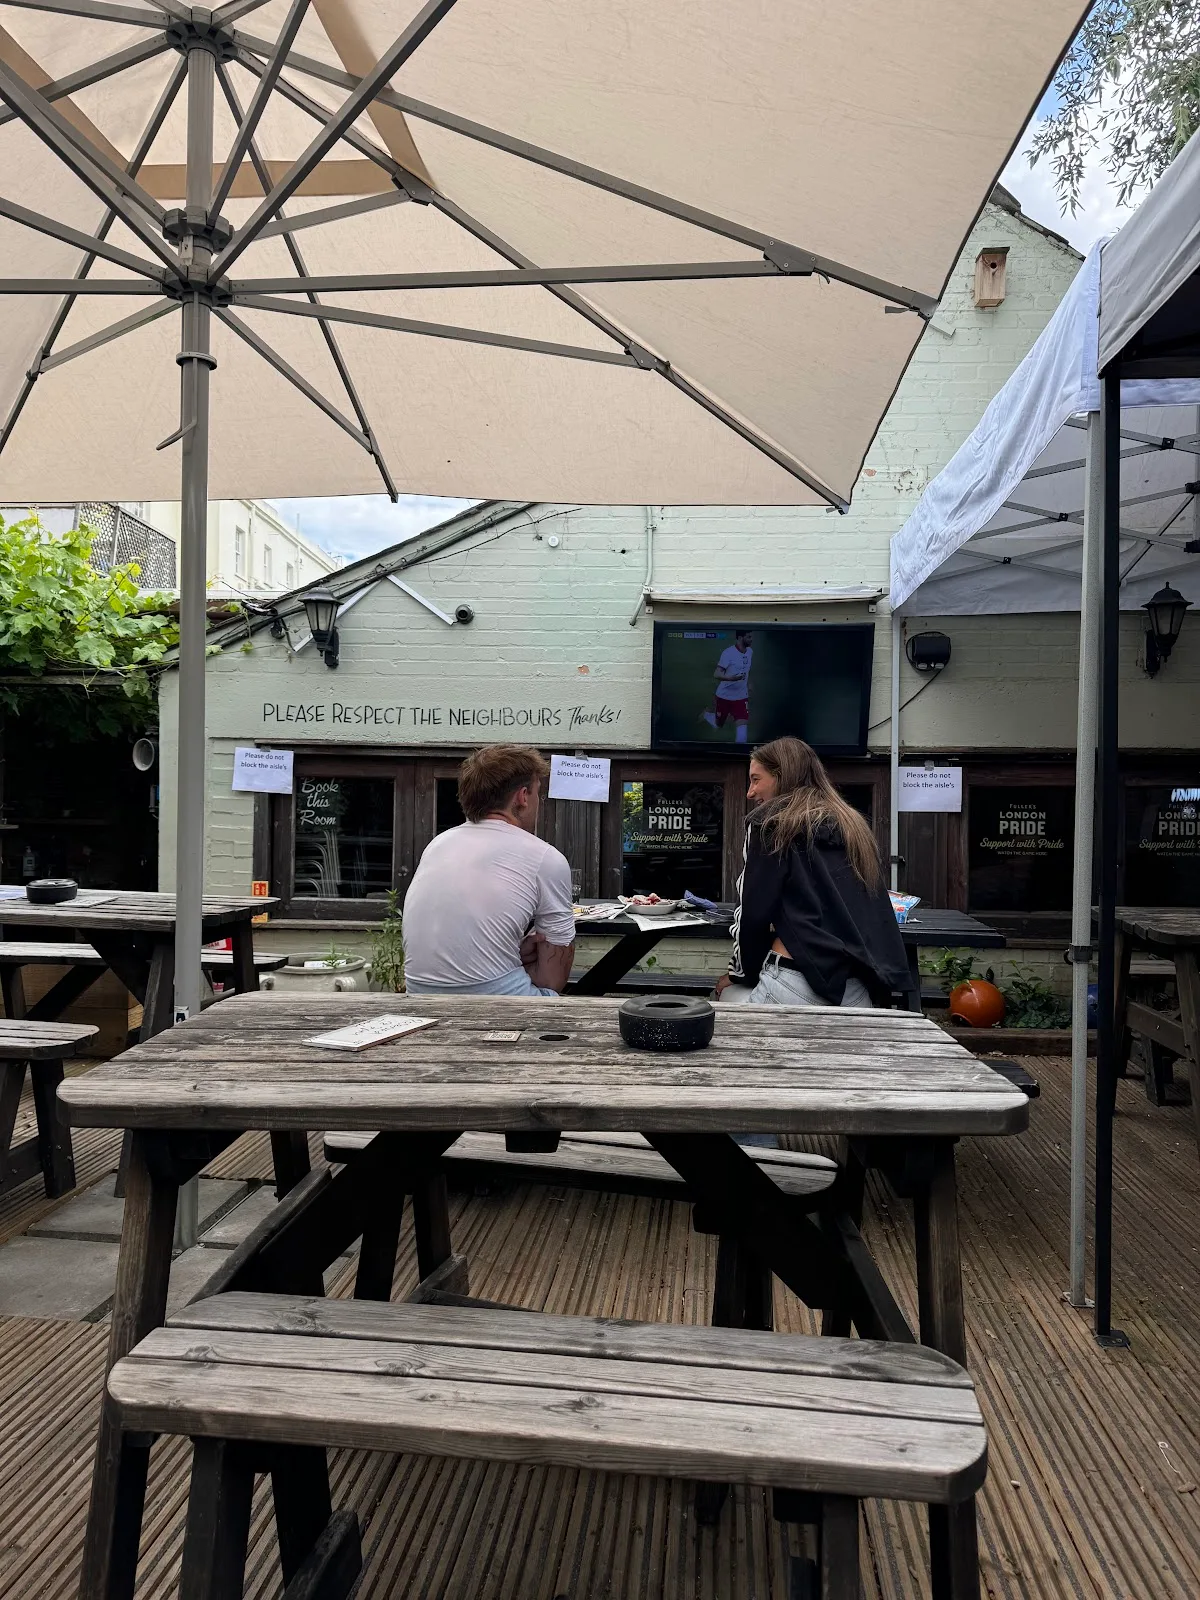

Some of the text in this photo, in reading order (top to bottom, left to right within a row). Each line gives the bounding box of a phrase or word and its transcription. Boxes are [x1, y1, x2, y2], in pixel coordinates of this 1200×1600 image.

[262, 703, 622, 731] PLEASE RESPECT THE NEIGHBOURS Thanks!
[301, 777, 339, 793] Book
[306, 792, 330, 808] this
[648, 806, 692, 814] LONDON
[300, 810, 337, 825] Room
[648, 816, 692, 830] PRIDE
[1000, 821, 1046, 835] PRIDE
[631, 832, 708, 843] Support with Pride
[980, 838, 1064, 849] Support with Pride
[1139, 839, 1174, 850] Support
[1176, 840, 1196, 848] with
